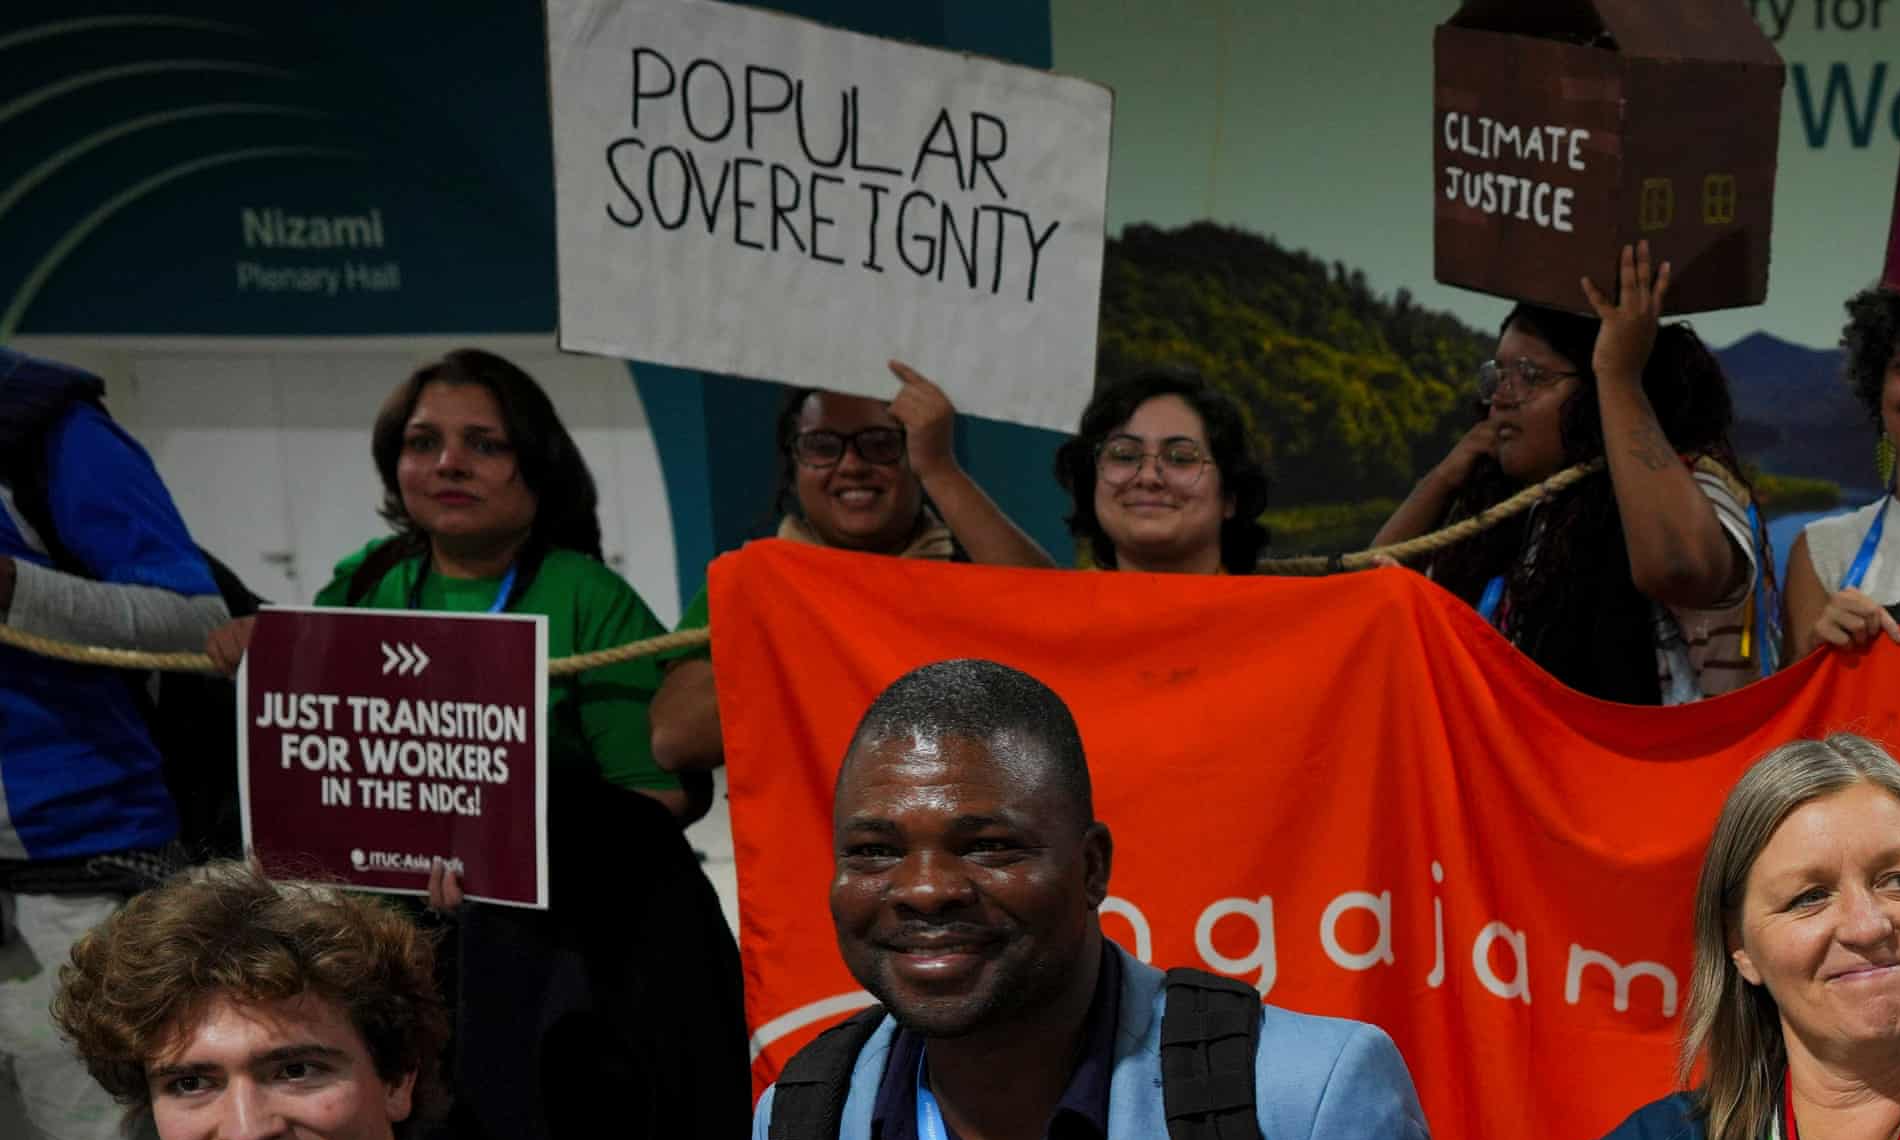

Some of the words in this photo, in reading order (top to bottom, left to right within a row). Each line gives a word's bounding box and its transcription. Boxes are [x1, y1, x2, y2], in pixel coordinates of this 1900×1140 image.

[631, 47, 1007, 199] POPULAR
[1444, 111, 1591, 171] CLIMATE
[605, 138, 1060, 302] SOVEREIGNTY
[1444, 166, 1575, 232] JUSTICE
[241, 207, 385, 248] Nizami
[256, 691, 339, 731] JUST
[347, 695, 527, 743] TRANSITION
[281, 733, 352, 773] FOR
[359, 738, 510, 784] WORKERS
[321, 776, 351, 807] IN
[357, 778, 413, 811] THE
[419, 782, 482, 817] NDCs!
